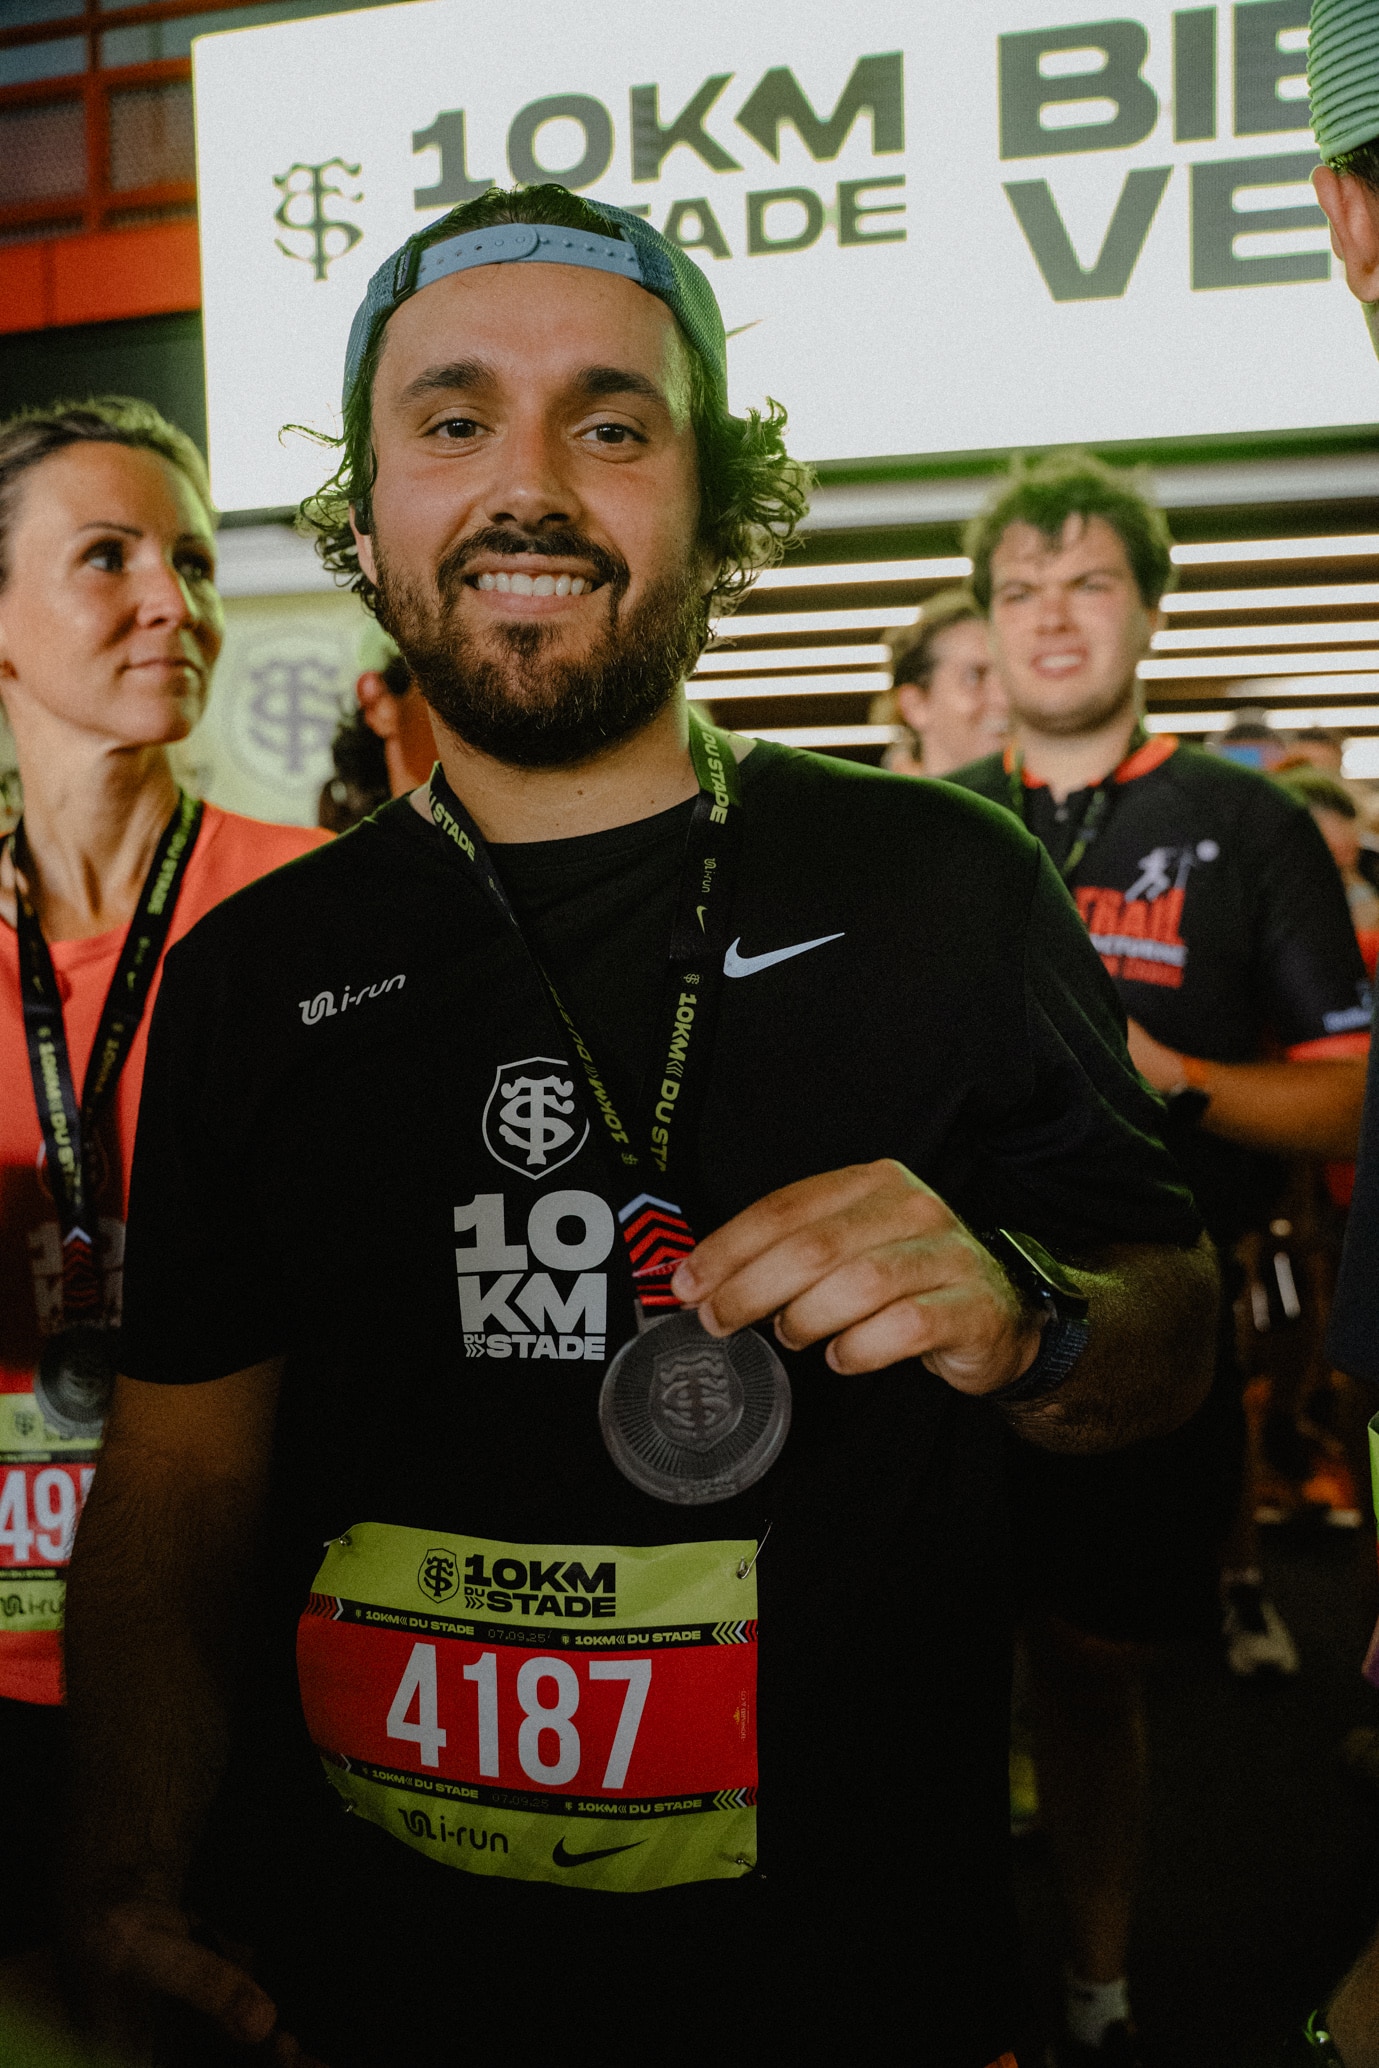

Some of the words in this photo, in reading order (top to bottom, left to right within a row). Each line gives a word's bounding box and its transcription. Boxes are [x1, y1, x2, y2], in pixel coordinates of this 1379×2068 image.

[411, 49, 906, 212] 10KM
[622, 173, 908, 261] ADE
[702, 731, 720, 759] DU
[707, 756, 730, 825] STADE
[433, 802, 477, 863] STADE
[341, 974, 407, 1012] i-run
[668, 992, 698, 1062] 10KM
[588, 1077, 630, 1144] 10KM
[655, 1078, 681, 1124] DU
[453, 1189, 616, 1273] 10
[457, 1272, 608, 1334] KM
[463, 1334, 487, 1345] DU
[485, 1334, 607, 1361] STADE
[464, 1553, 617, 1594] 10KM
[365, 1610, 401, 1625] 10KM
[409, 1617, 429, 1629] DU
[430, 1621, 476, 1636] STADE
[464, 1586, 486, 1598] DU
[485, 1590, 617, 1619] STADE
[575, 1634, 617, 1646] 10KM
[627, 1633, 650, 1645] DU
[652, 1629, 702, 1644] STADE
[385, 1641, 653, 1790] 4187
[371, 1769, 406, 1785] 10KM
[414, 1779, 433, 1790] DU
[435, 1783, 480, 1799] STADE
[577, 1801, 618, 1814] 10KM
[629, 1802, 651, 1814] DU
[654, 1799, 703, 1813] STADE
[440, 1815, 509, 1854] i-run
